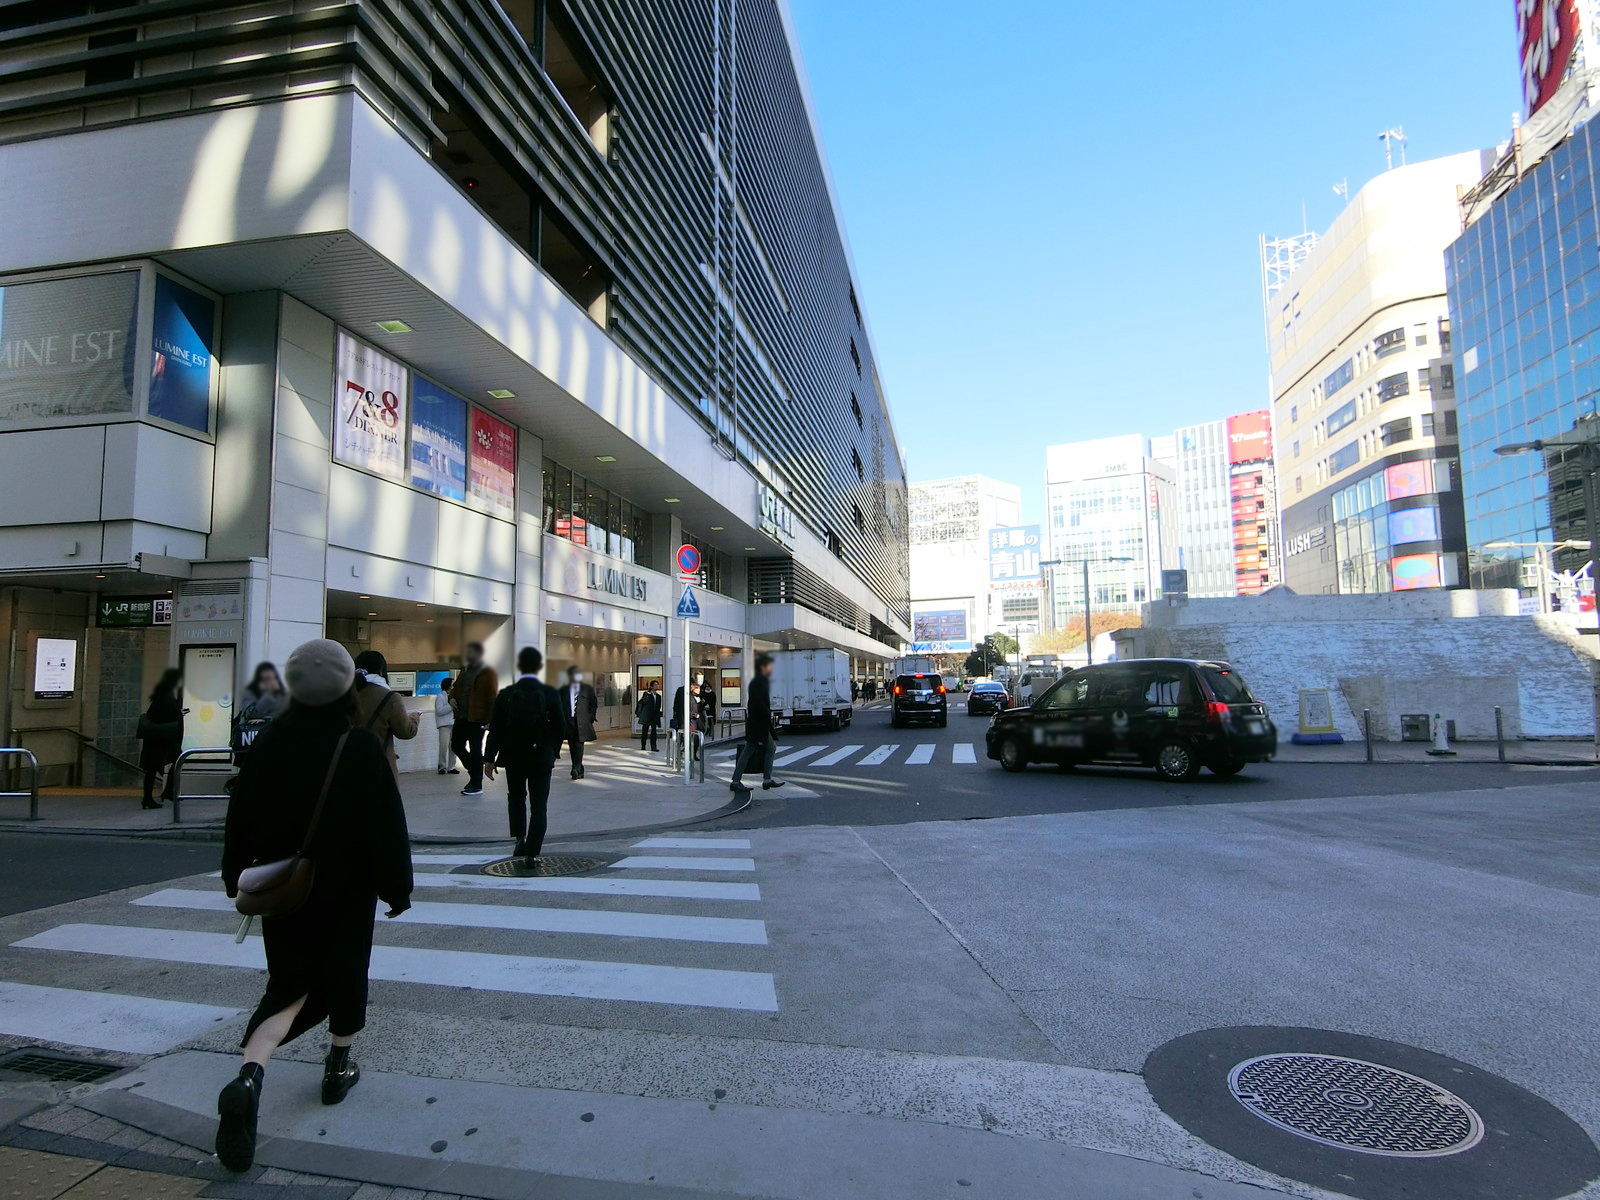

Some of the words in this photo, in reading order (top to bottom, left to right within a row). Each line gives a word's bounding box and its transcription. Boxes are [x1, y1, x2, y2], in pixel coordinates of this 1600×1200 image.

[71, 330, 120, 362] EST
[155, 338, 190, 360] LUMINE
[192, 353, 208, 367] EST
[346, 380, 399, 429] 7&8
[449, 438, 462, 454] EST
[1105, 463, 1127, 472] SMBC
[1286, 531, 1311, 557] LUSH
[990, 549, 1040, 579] 青山
[586, 562, 632, 598] LUMINE
[632, 576, 648, 601] EST
[115, 603, 129, 611] JR
[931, 642, 950, 650] DHC
[241, 730, 259, 747] NI
